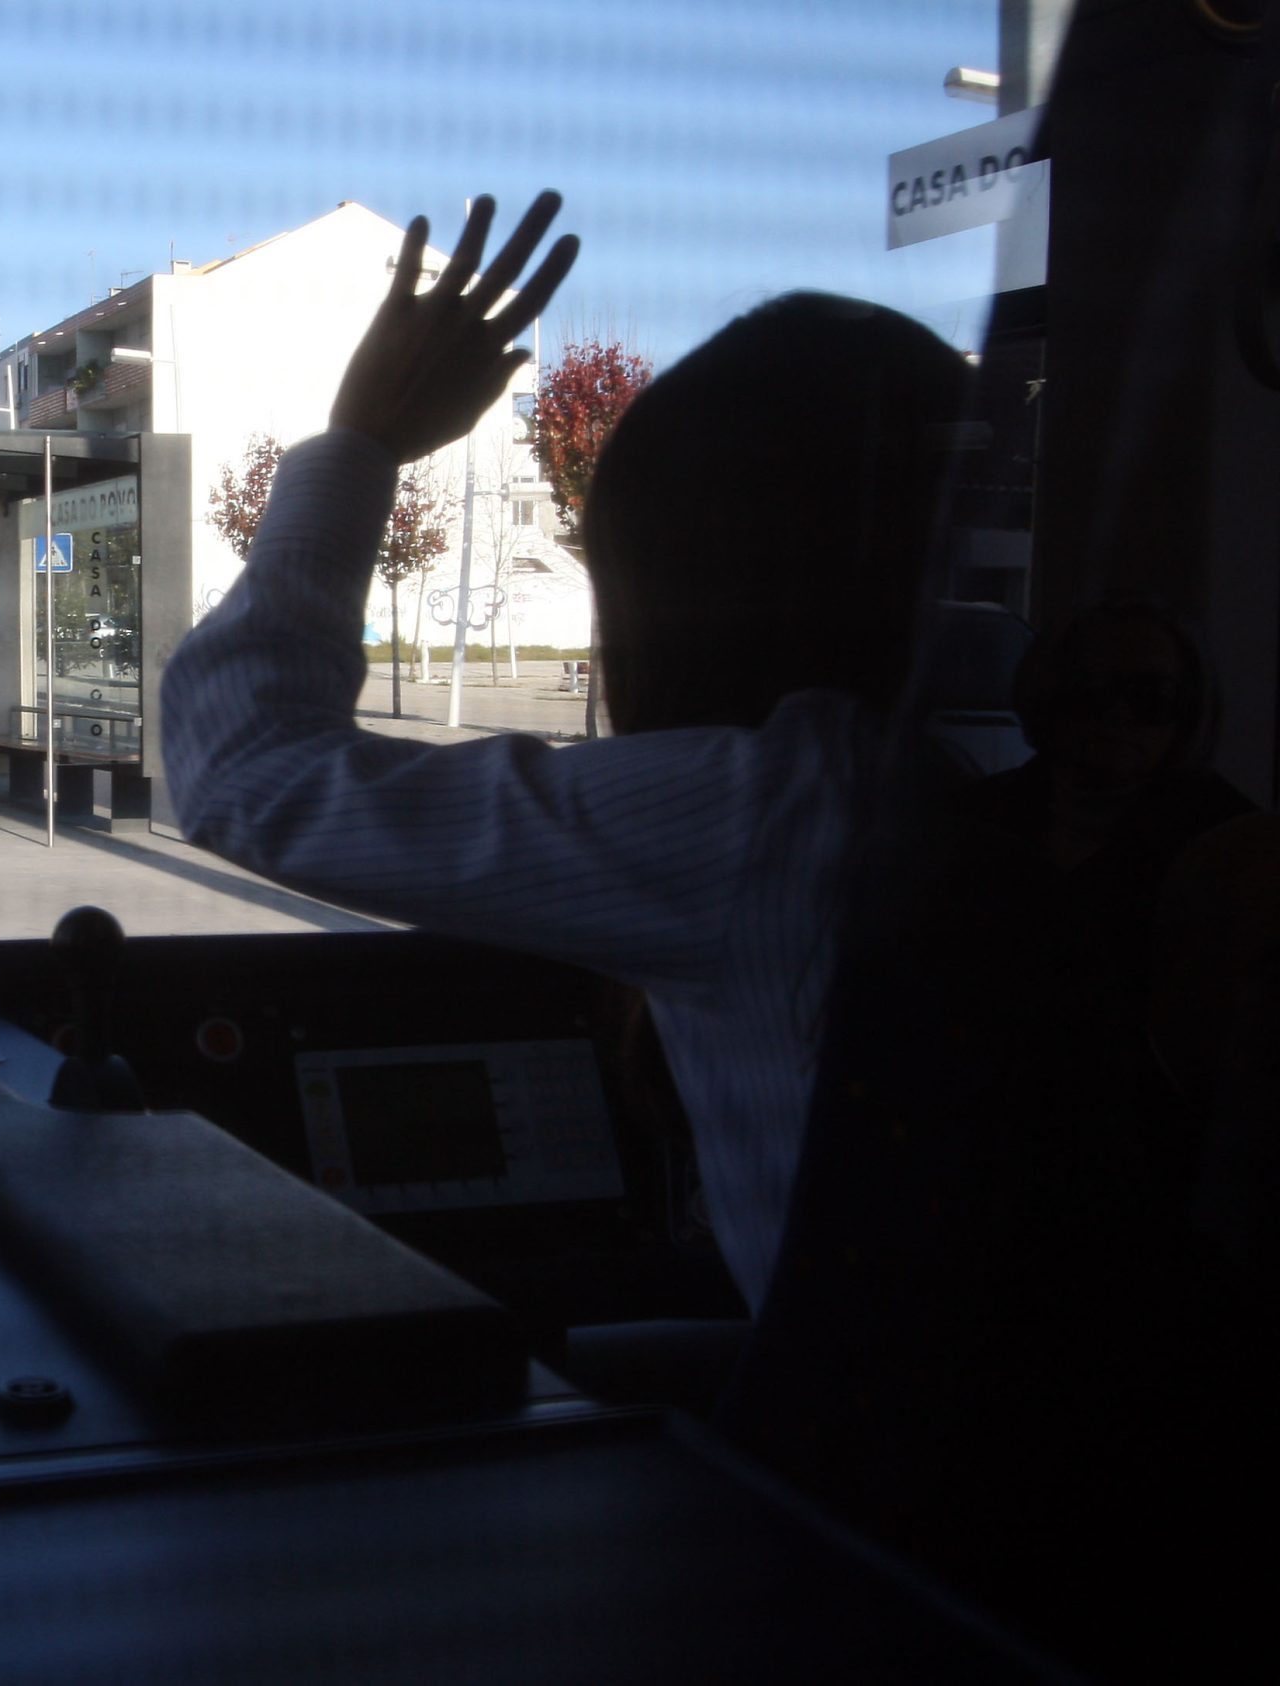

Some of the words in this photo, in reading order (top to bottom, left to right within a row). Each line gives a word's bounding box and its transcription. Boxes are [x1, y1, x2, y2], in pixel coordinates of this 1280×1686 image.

[892, 164, 968, 216] CASA
[980, 145, 1028, 192] DO
[51, 499, 78, 527] CASA
[99, 486, 137, 519] POVO
[90, 531, 102, 597] CASA
[90, 619, 103, 649] DO
